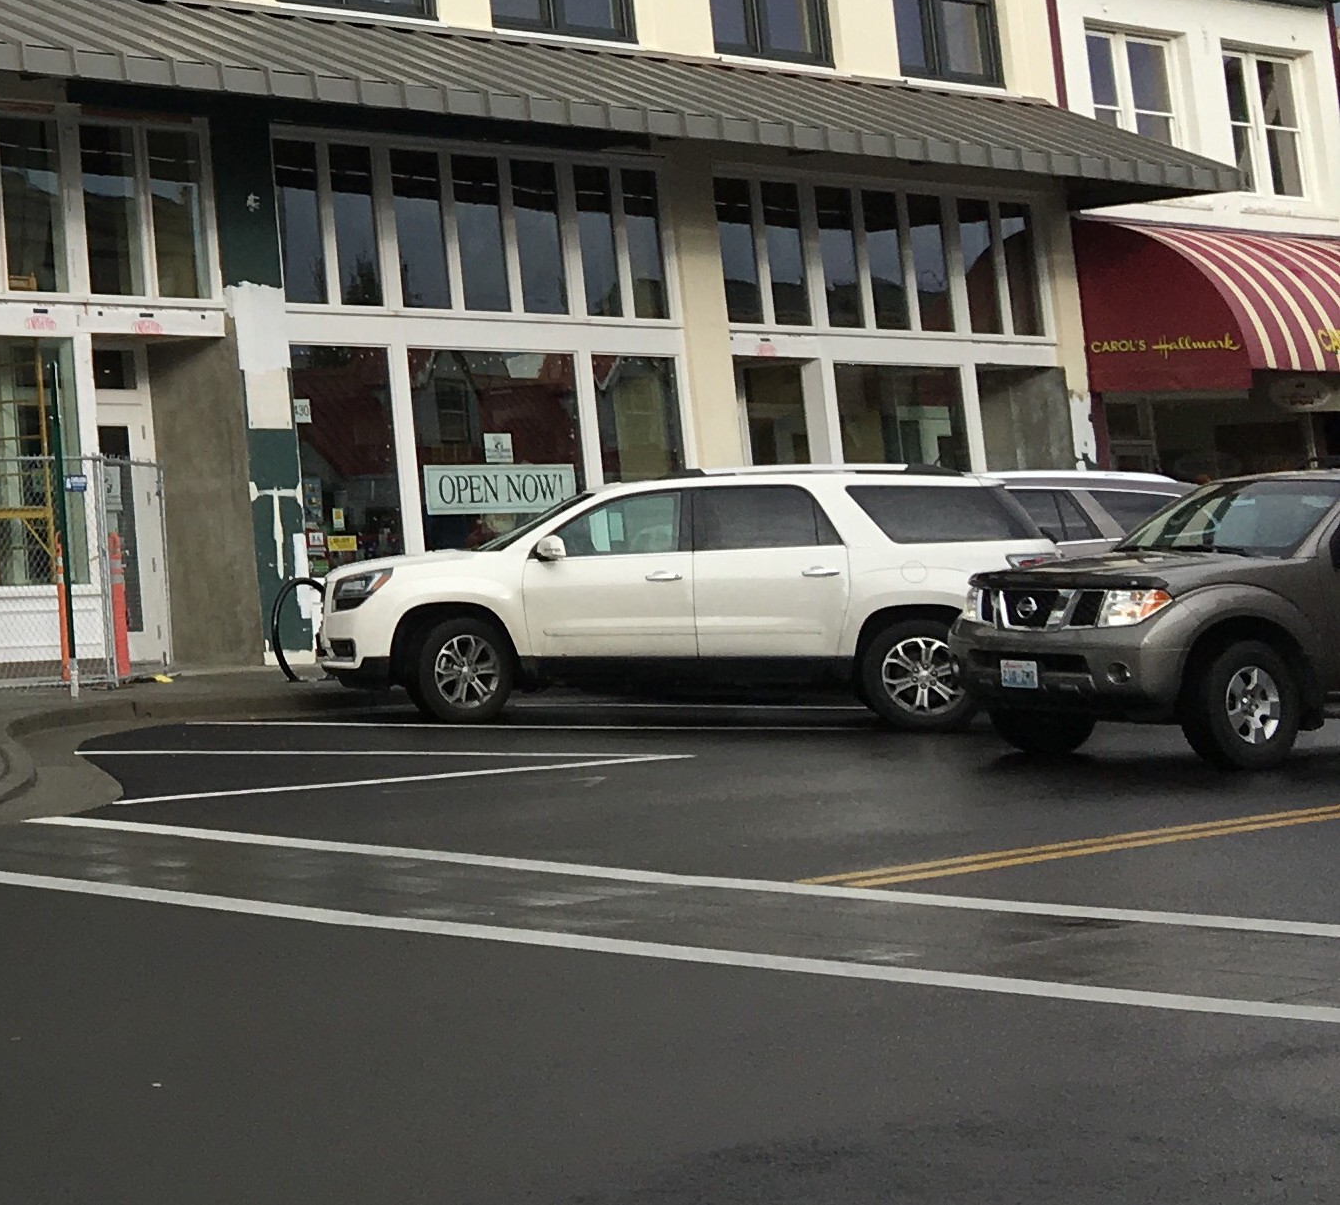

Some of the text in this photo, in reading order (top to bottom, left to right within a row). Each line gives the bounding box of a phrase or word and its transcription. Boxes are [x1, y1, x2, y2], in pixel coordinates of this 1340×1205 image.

[1091, 332, 1241, 359] CAROL'S Hallmark
[438, 473, 564, 504] OPEN NOW!
